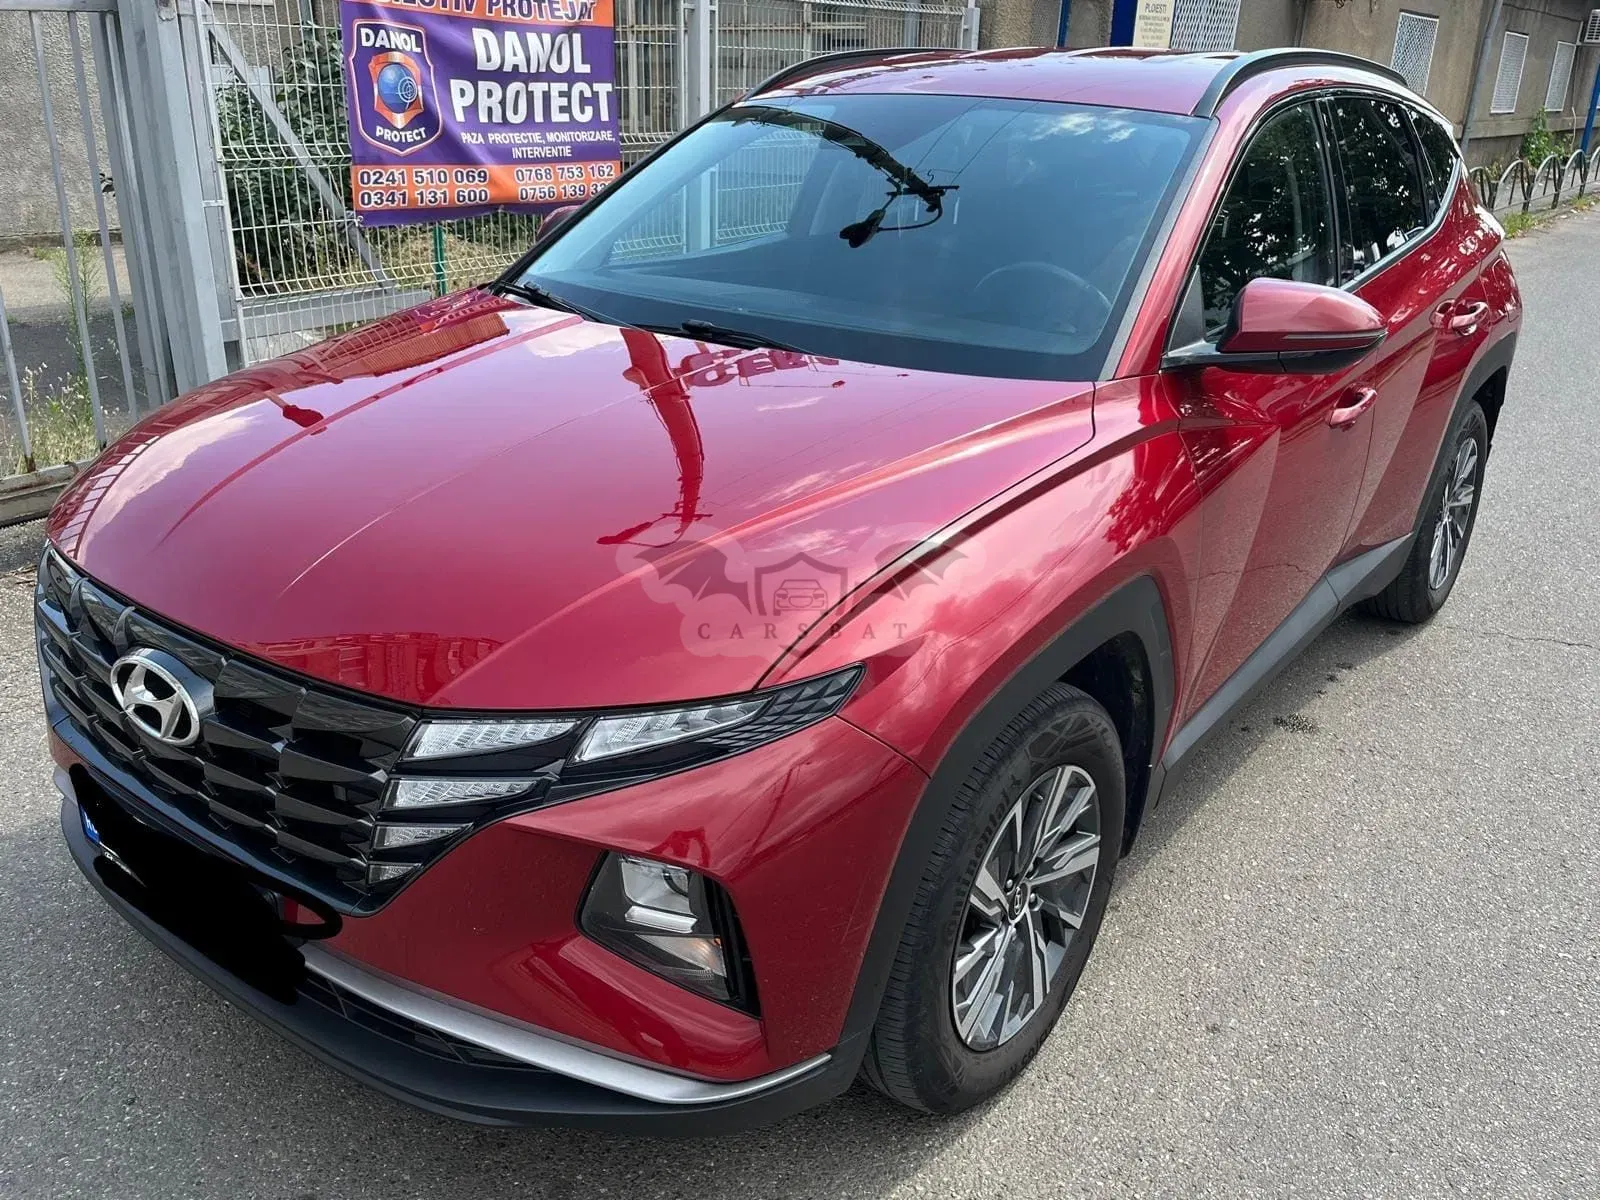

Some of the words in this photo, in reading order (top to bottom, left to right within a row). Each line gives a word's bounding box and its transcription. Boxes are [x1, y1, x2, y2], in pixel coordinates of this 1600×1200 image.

[360, 28, 422, 53] DANOL
[472, 28, 591, 74] DANOL
[449, 79, 613, 124] PROTECT
[375, 126, 427, 143] PROTECT
[461, 132, 485, 144] PAZA
[488, 132, 546, 144] PROTECTIE,
[546, 130, 616, 143] MONITORIZARE,
[512, 146, 573, 159] INTERVENTIE
[359, 169, 407, 185] 0241
[413, 168, 448, 185] 510
[454, 168, 488, 184] 069
[515, 167, 553, 182] 0768
[557, 166, 584, 180] 753
[589, 164, 614, 178] 162
[360, 190, 408, 207] 0341
[416, 189, 449, 205] 131
[456, 189, 488, 203] 600
[519, 186, 556, 201] 0756
[561, 184, 586, 199] 139
